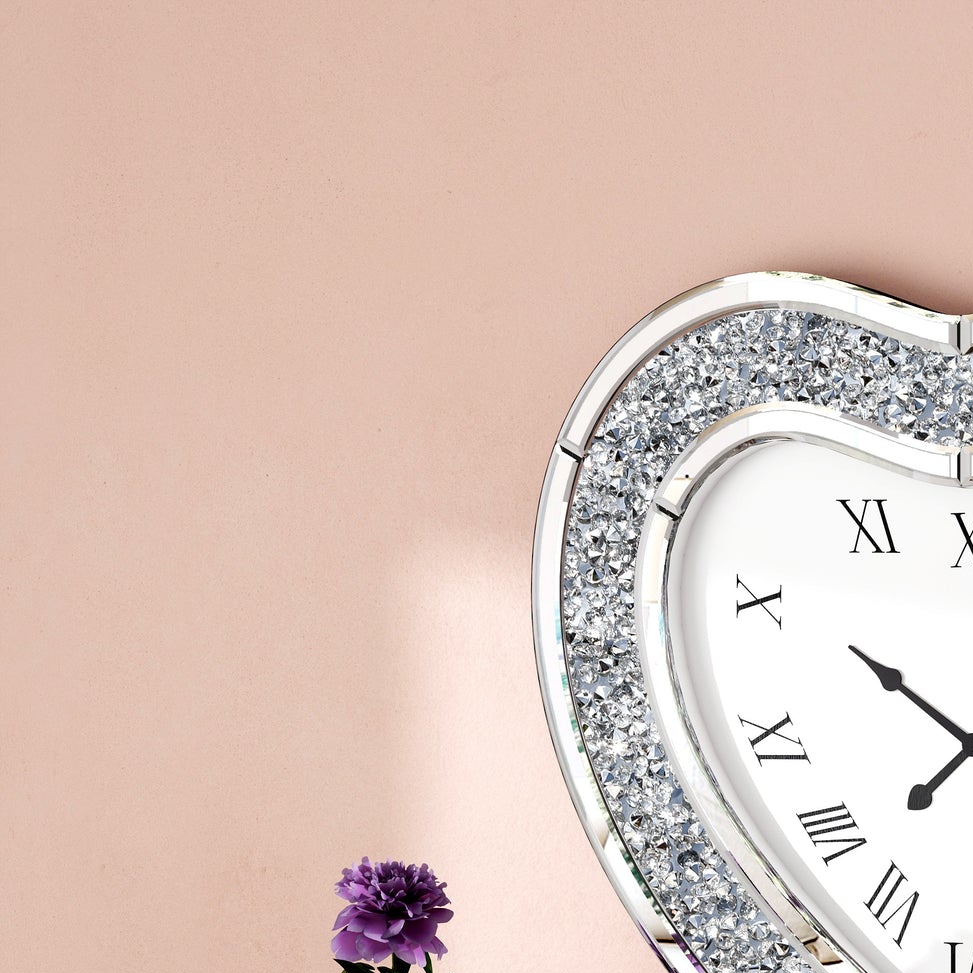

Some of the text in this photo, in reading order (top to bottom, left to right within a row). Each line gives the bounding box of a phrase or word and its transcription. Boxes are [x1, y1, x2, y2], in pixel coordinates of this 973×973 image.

[836, 498, 901, 554] XI
[736, 573, 782, 630] X
[737, 711, 812, 767] IX
[796, 801, 867, 866] VIII
[863, 859, 920, 950] VII
